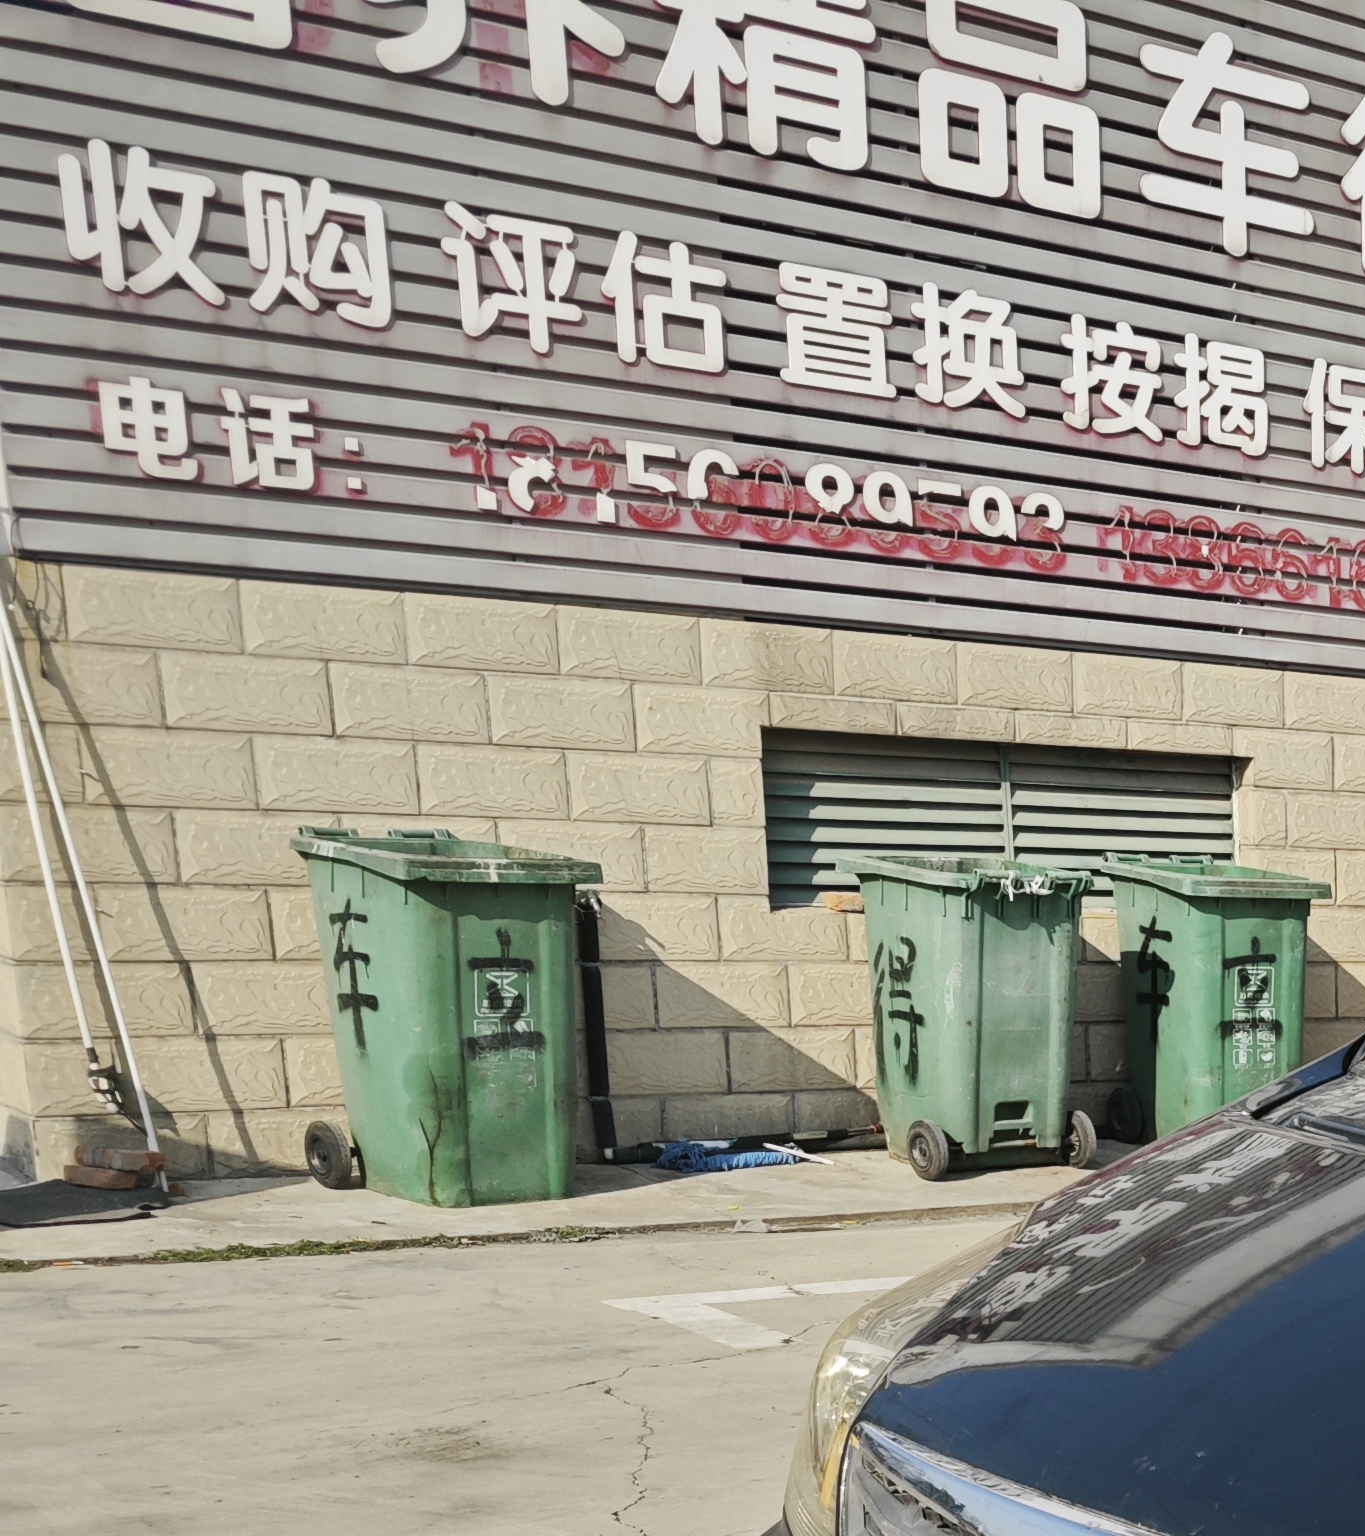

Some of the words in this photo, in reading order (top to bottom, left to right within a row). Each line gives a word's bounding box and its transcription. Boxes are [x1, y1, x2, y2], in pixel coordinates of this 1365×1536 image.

[57, 138, 396, 329] 收购
[440, 201, 728, 373] 评估
[776, 261, 1026, 418] 置换
[1061, 314, 1269, 458] 按揭
